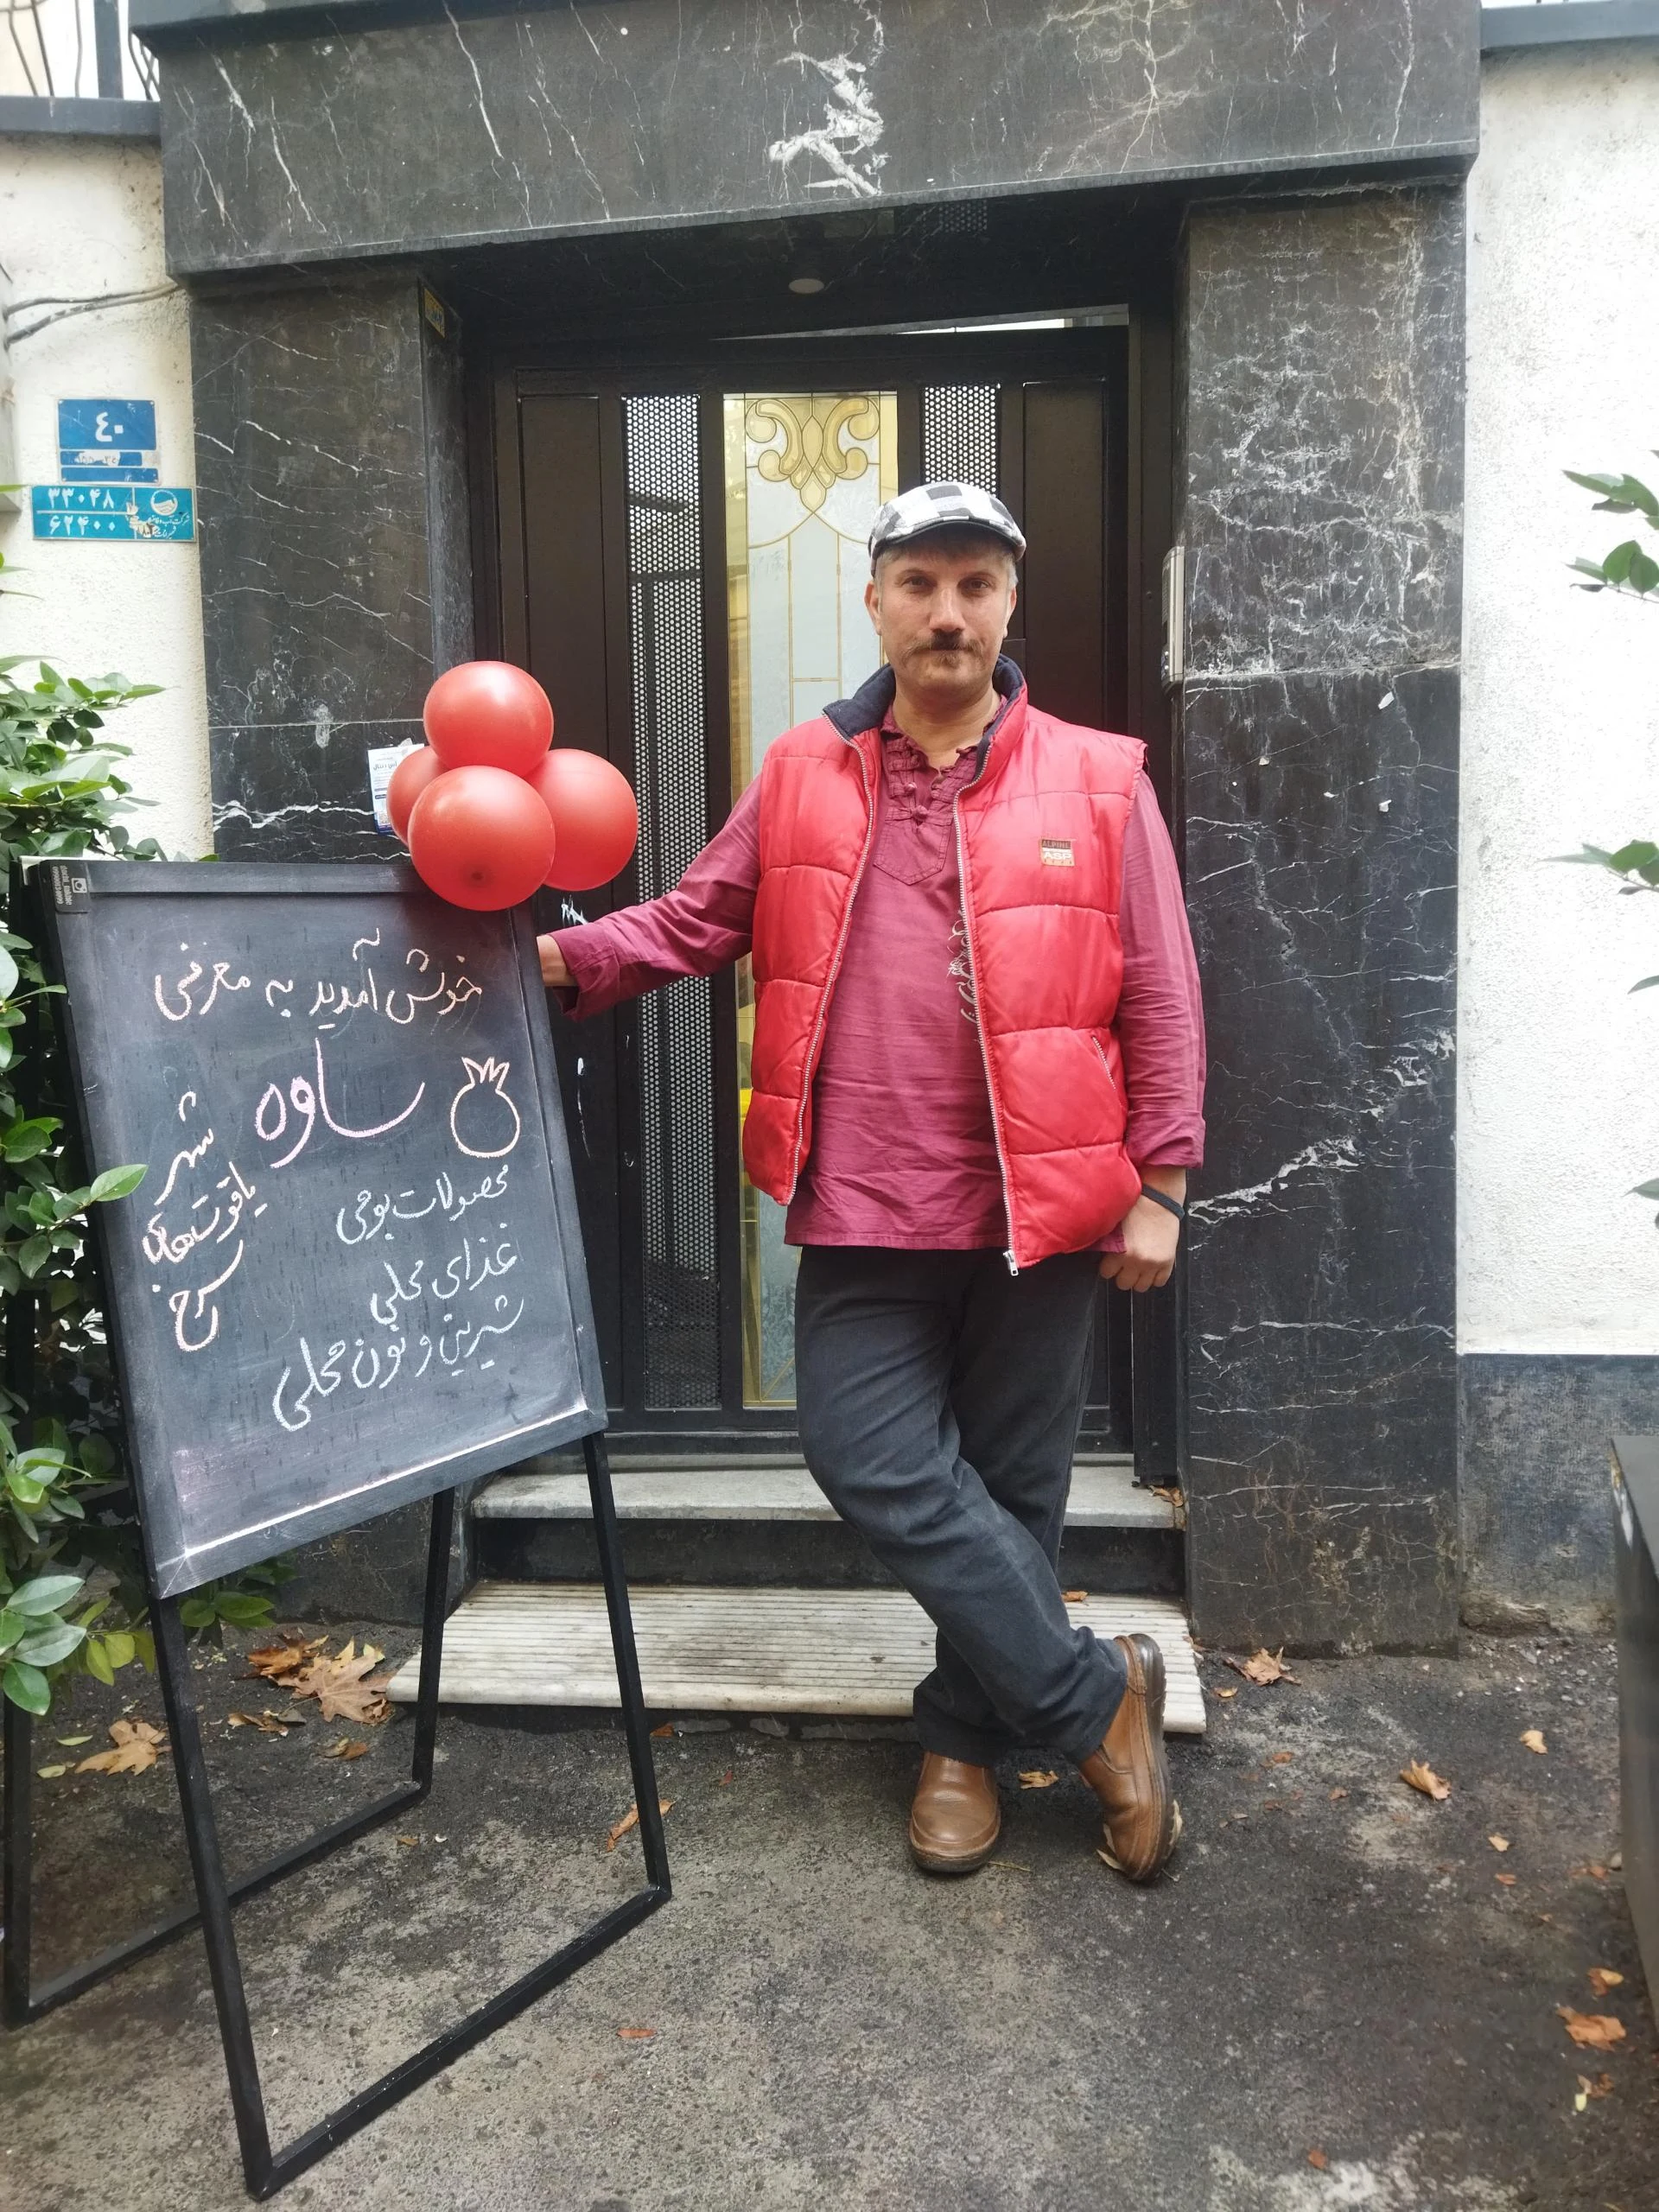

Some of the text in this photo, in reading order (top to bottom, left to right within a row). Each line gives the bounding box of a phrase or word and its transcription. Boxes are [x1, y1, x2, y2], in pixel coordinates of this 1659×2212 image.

[48, 487, 115, 509] ۳۳۰۴۸
[155, 928, 483, 1030] خوش آمدید به معرفی
[255, 1037, 426, 1169] ساوه
[336, 1165, 508, 1245] محصولات بومی
[152, 1239, 244, 1352] سرخ
[370, 1223, 518, 1325] غذای محلی
[272, 1337, 346, 1432] محلی
[352, 1325, 406, 1389] نون
[415, 1334, 433, 1377] و
